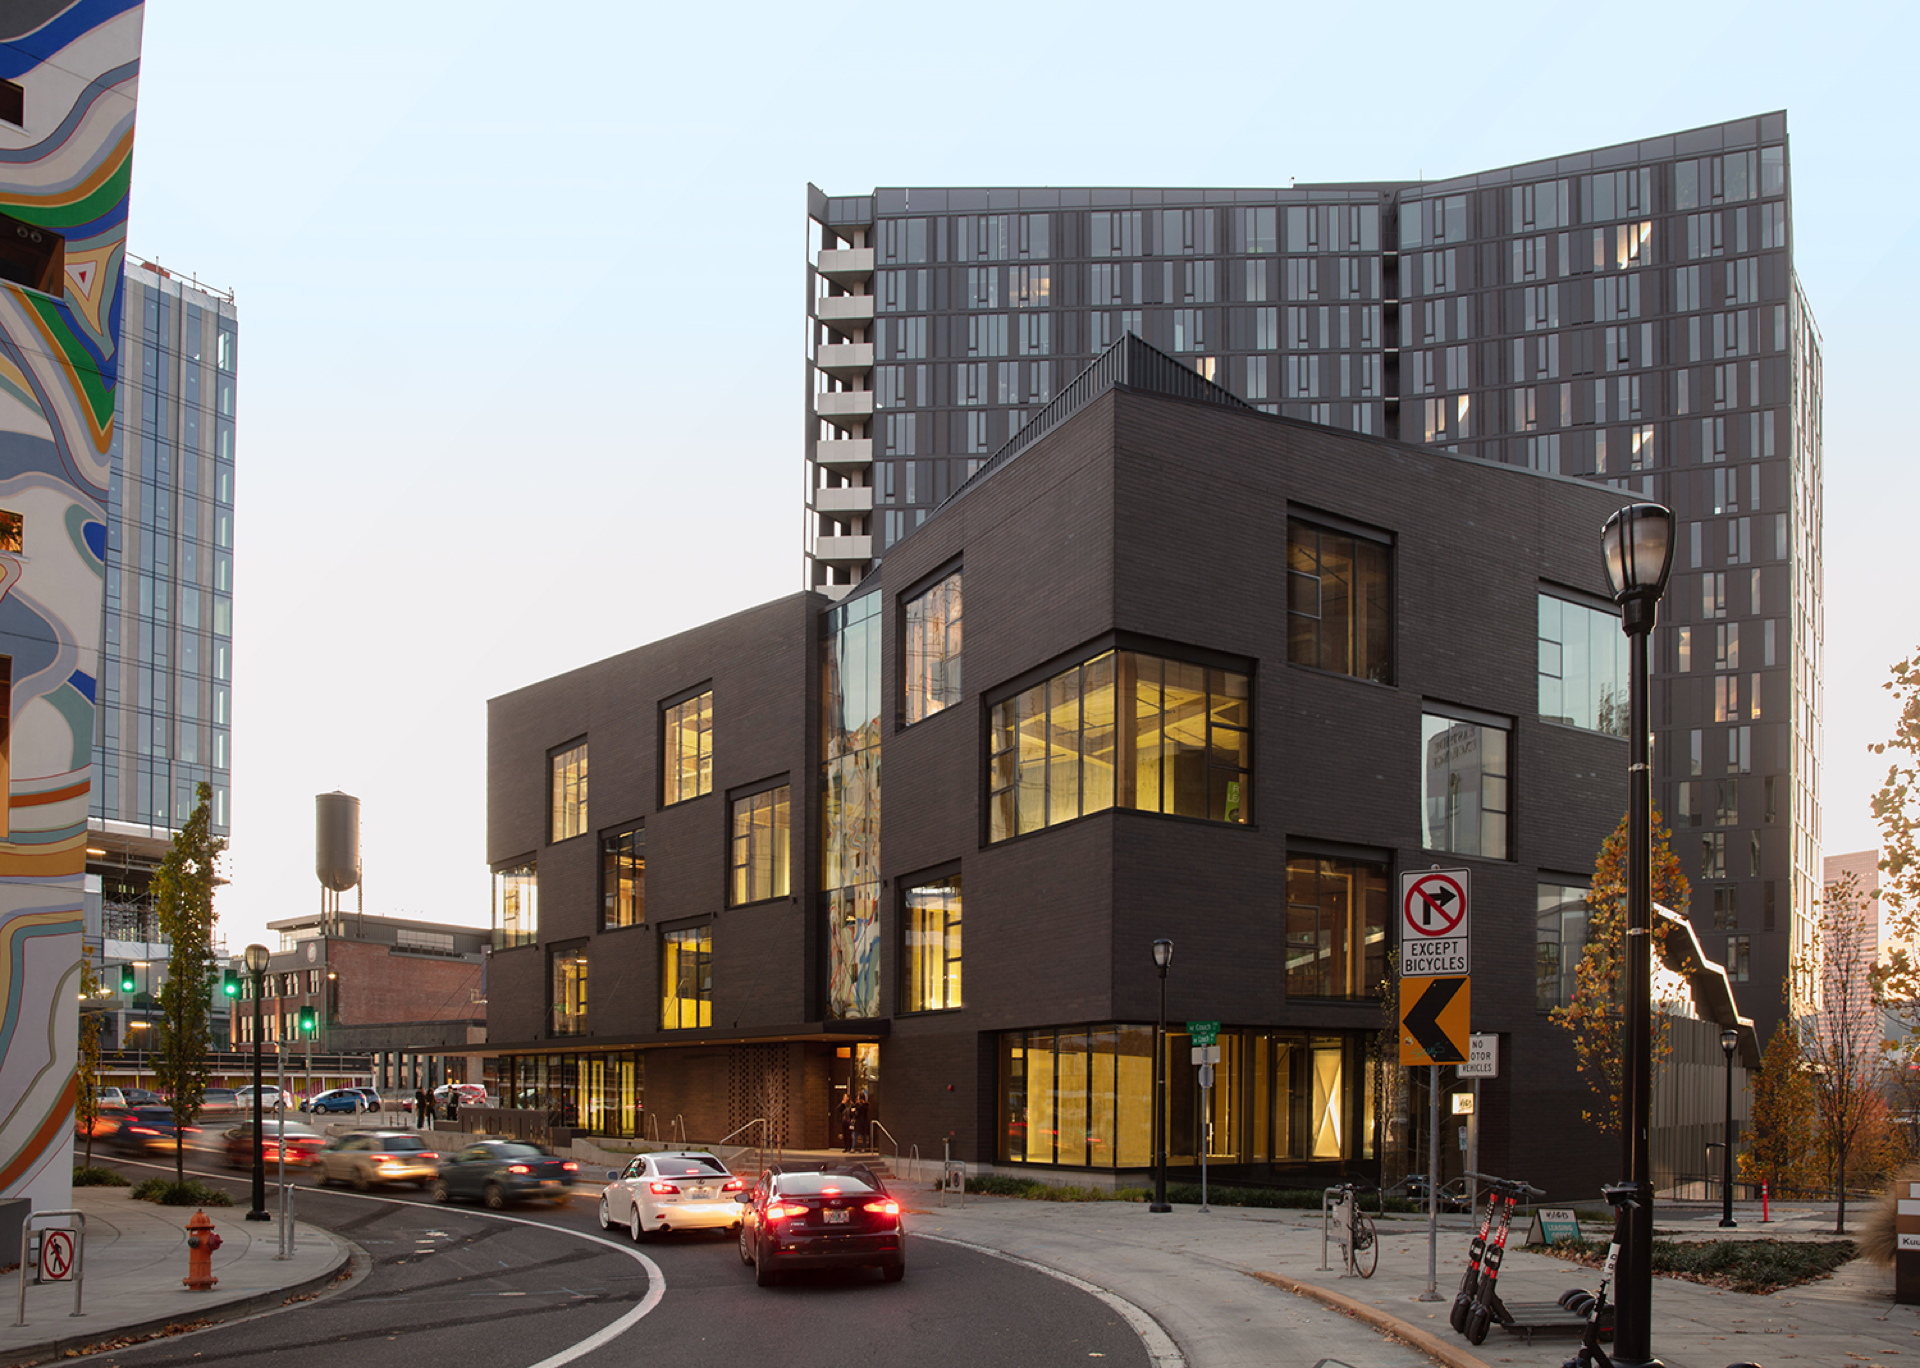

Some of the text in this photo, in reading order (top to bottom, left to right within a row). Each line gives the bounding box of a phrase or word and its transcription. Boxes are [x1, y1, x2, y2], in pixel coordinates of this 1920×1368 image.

[1411, 942, 1458, 956] EXCEPT
[1405, 957, 1465, 972] BICYCLES
[1472, 1040, 1483, 1049] NO
[1470, 1051, 1491, 1061] OTOR
[1462, 1063, 1492, 1073] VEHICLES
